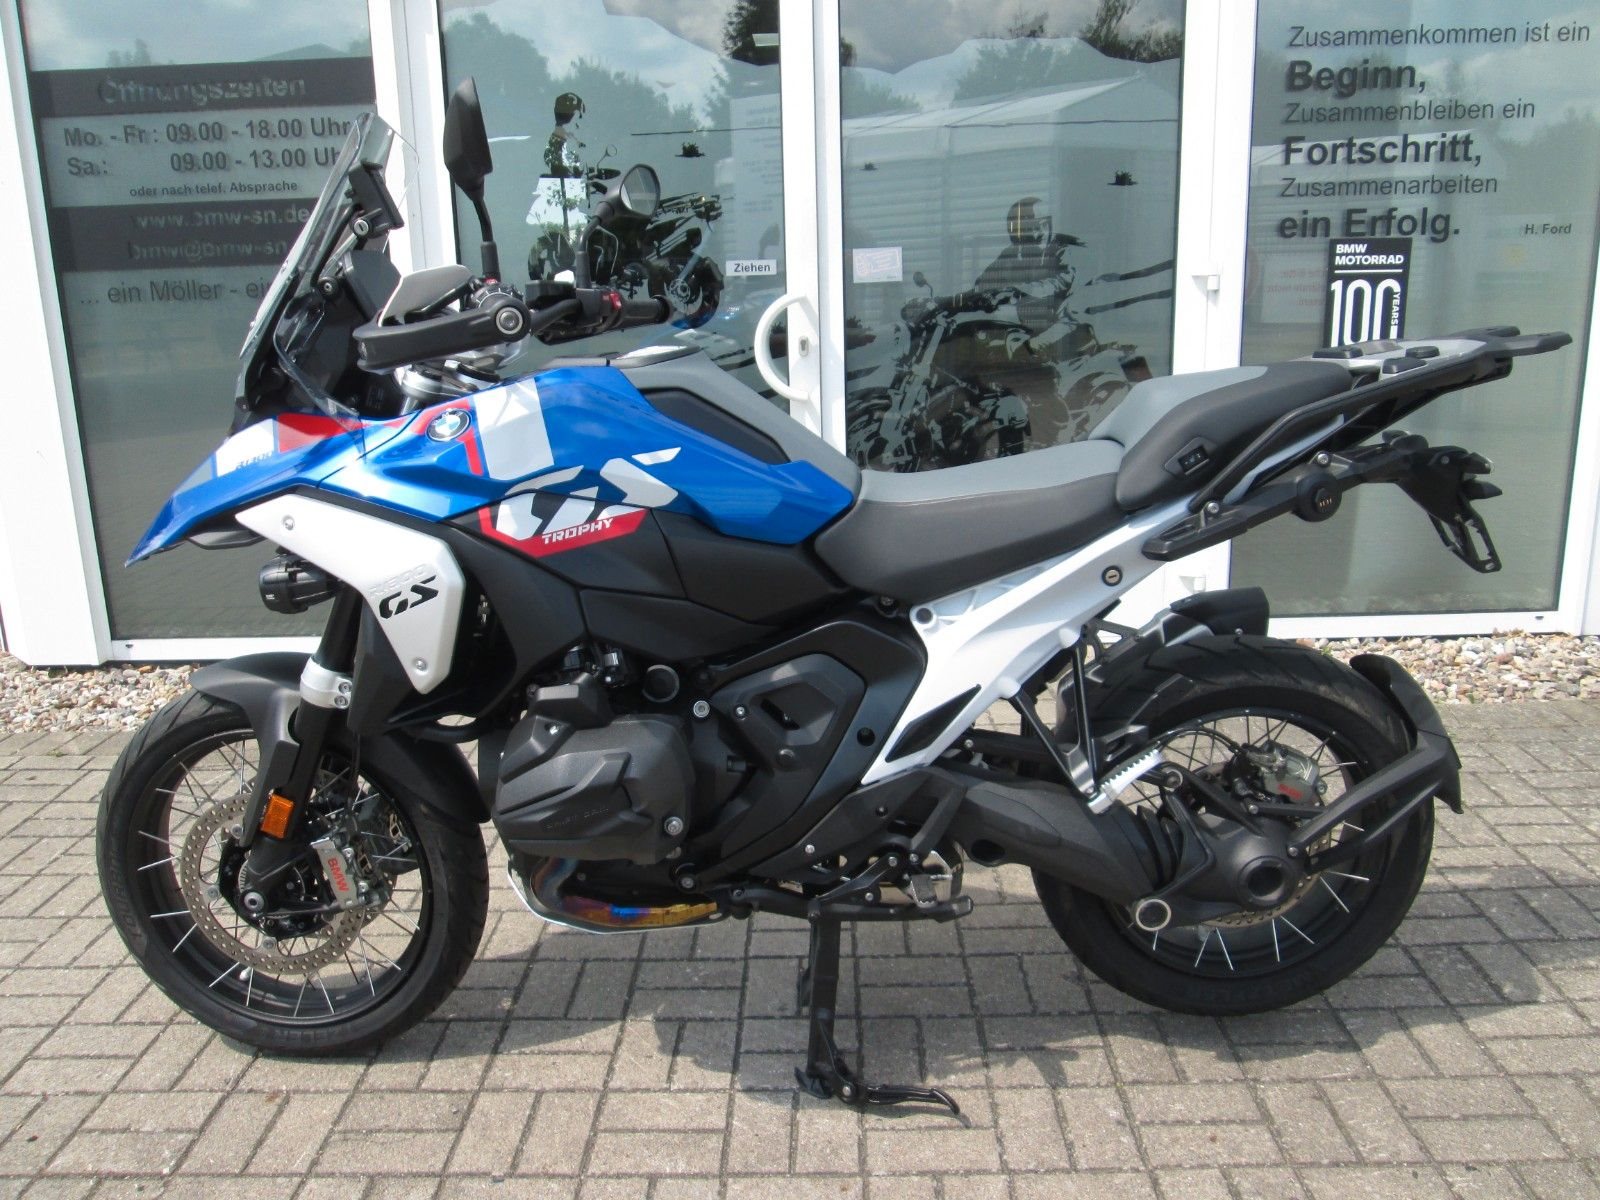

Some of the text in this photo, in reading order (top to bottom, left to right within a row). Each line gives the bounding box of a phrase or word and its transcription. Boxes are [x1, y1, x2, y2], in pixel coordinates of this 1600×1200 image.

[1288, 21, 1590, 48] Zusammenkommen ist ein
[1285, 59, 1427, 98] Beginn,
[1283, 98, 1535, 124] Zusammenbleiben ein
[166, 121, 223, 143] 09.00
[246, 118, 303, 139] 18.00
[310, 117, 350, 137] Uhr
[170, 152, 227, 172] 09.00
[249, 148, 306, 169] 13.00
[314, 147, 342, 166] Uh
[1284, 133, 1481, 167] Fortschritt,
[129, 181, 298, 198] oder nach telef. Absprache
[1281, 176, 1498, 198] Zusammenarbeiten
[1279, 207, 1460, 244] ein Erfolg.
[1525, 223, 1572, 235] H. Ford
[1334, 254, 1405, 266] MOTORRAD
[1335, 243, 1368, 255] BMW
[734, 262, 771, 273] Ziehen
[107, 281, 142, 303] ein
[150, 276, 222, 302] Möller
[1330, 278, 1402, 348] 100
[1390, 292, 1402, 326] YEARS
[541, 517, 614, 545] TROPHY
[379, 574, 440, 620] GS
[327, 857, 350, 892] BMW
